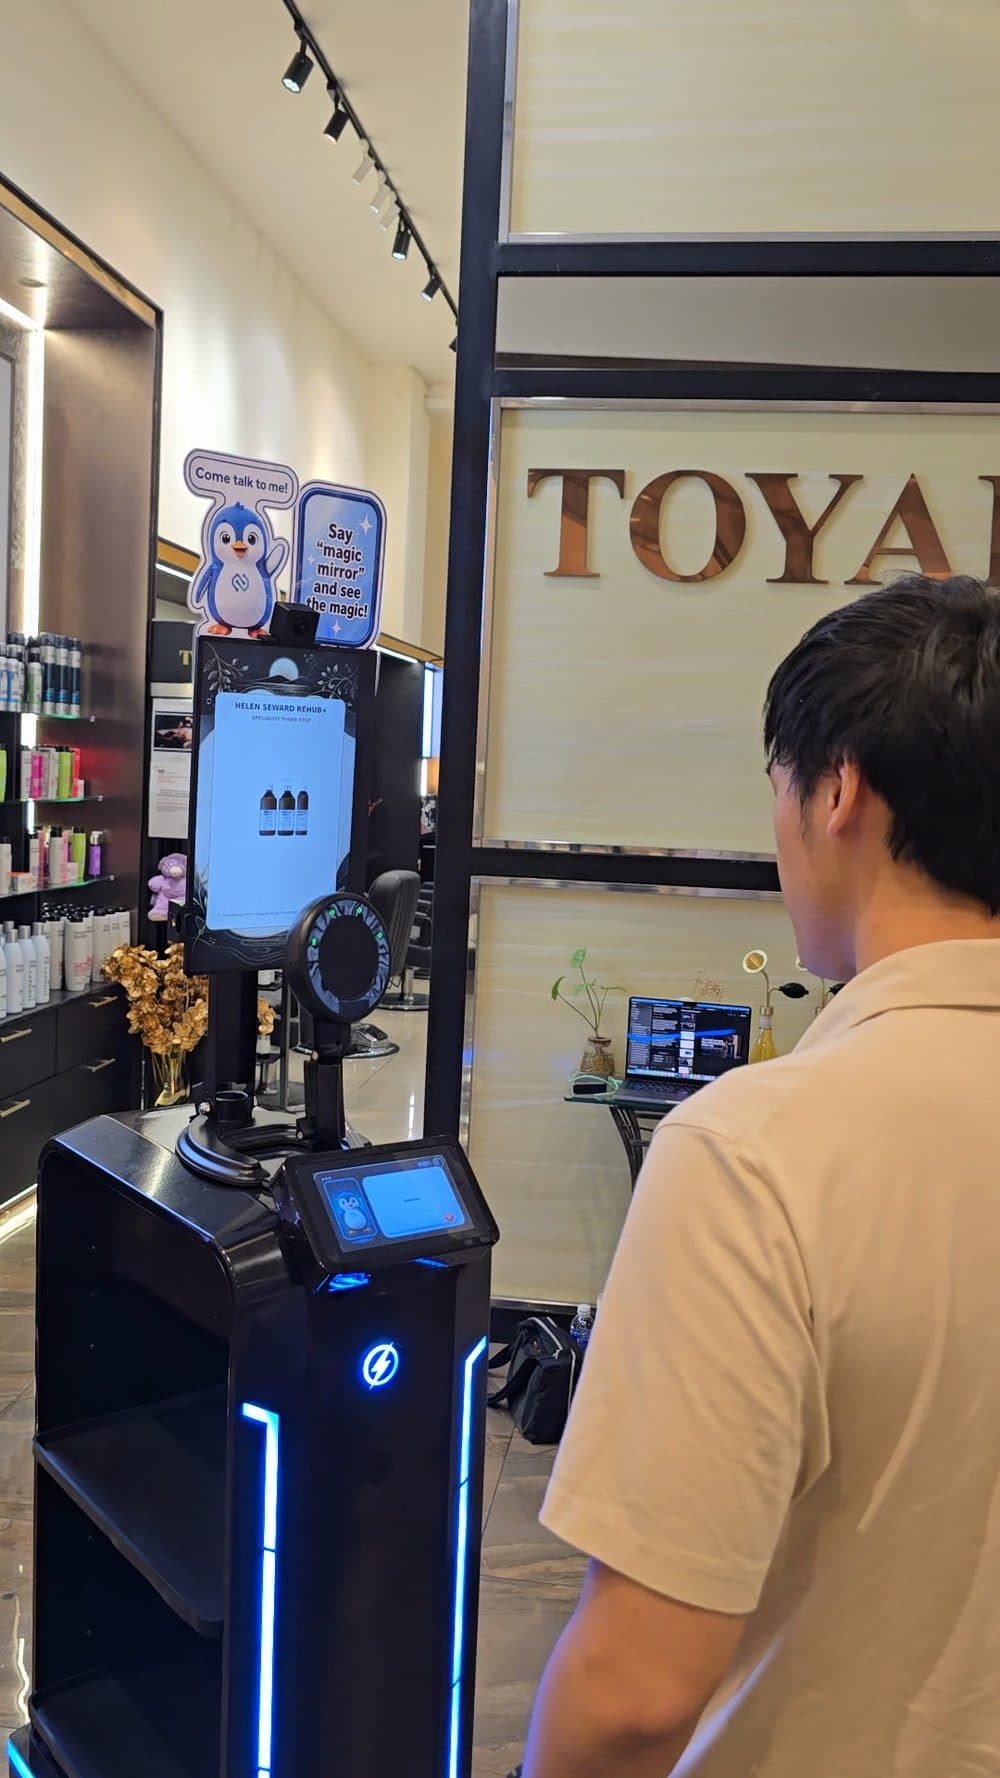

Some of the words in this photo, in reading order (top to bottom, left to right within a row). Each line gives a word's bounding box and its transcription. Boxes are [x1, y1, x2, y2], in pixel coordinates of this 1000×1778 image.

[195, 467, 231, 484] Come
[233, 475, 253, 488] talk
[256, 480, 266, 490] to
[268, 483, 288, 494] me!
[328, 523, 353, 545] Say
[316, 541, 362, 563] “magic
[317, 562, 365, 580] mirror”
[313, 582, 337, 595] and
[340, 586, 361, 599] see
[306, 597, 326, 611] the
[329, 602, 368, 618] magic!
[234, 701, 260, 710] HELEN
[262, 703, 294, 712] SEWARD
[296, 705, 327, 714] REHUB+
